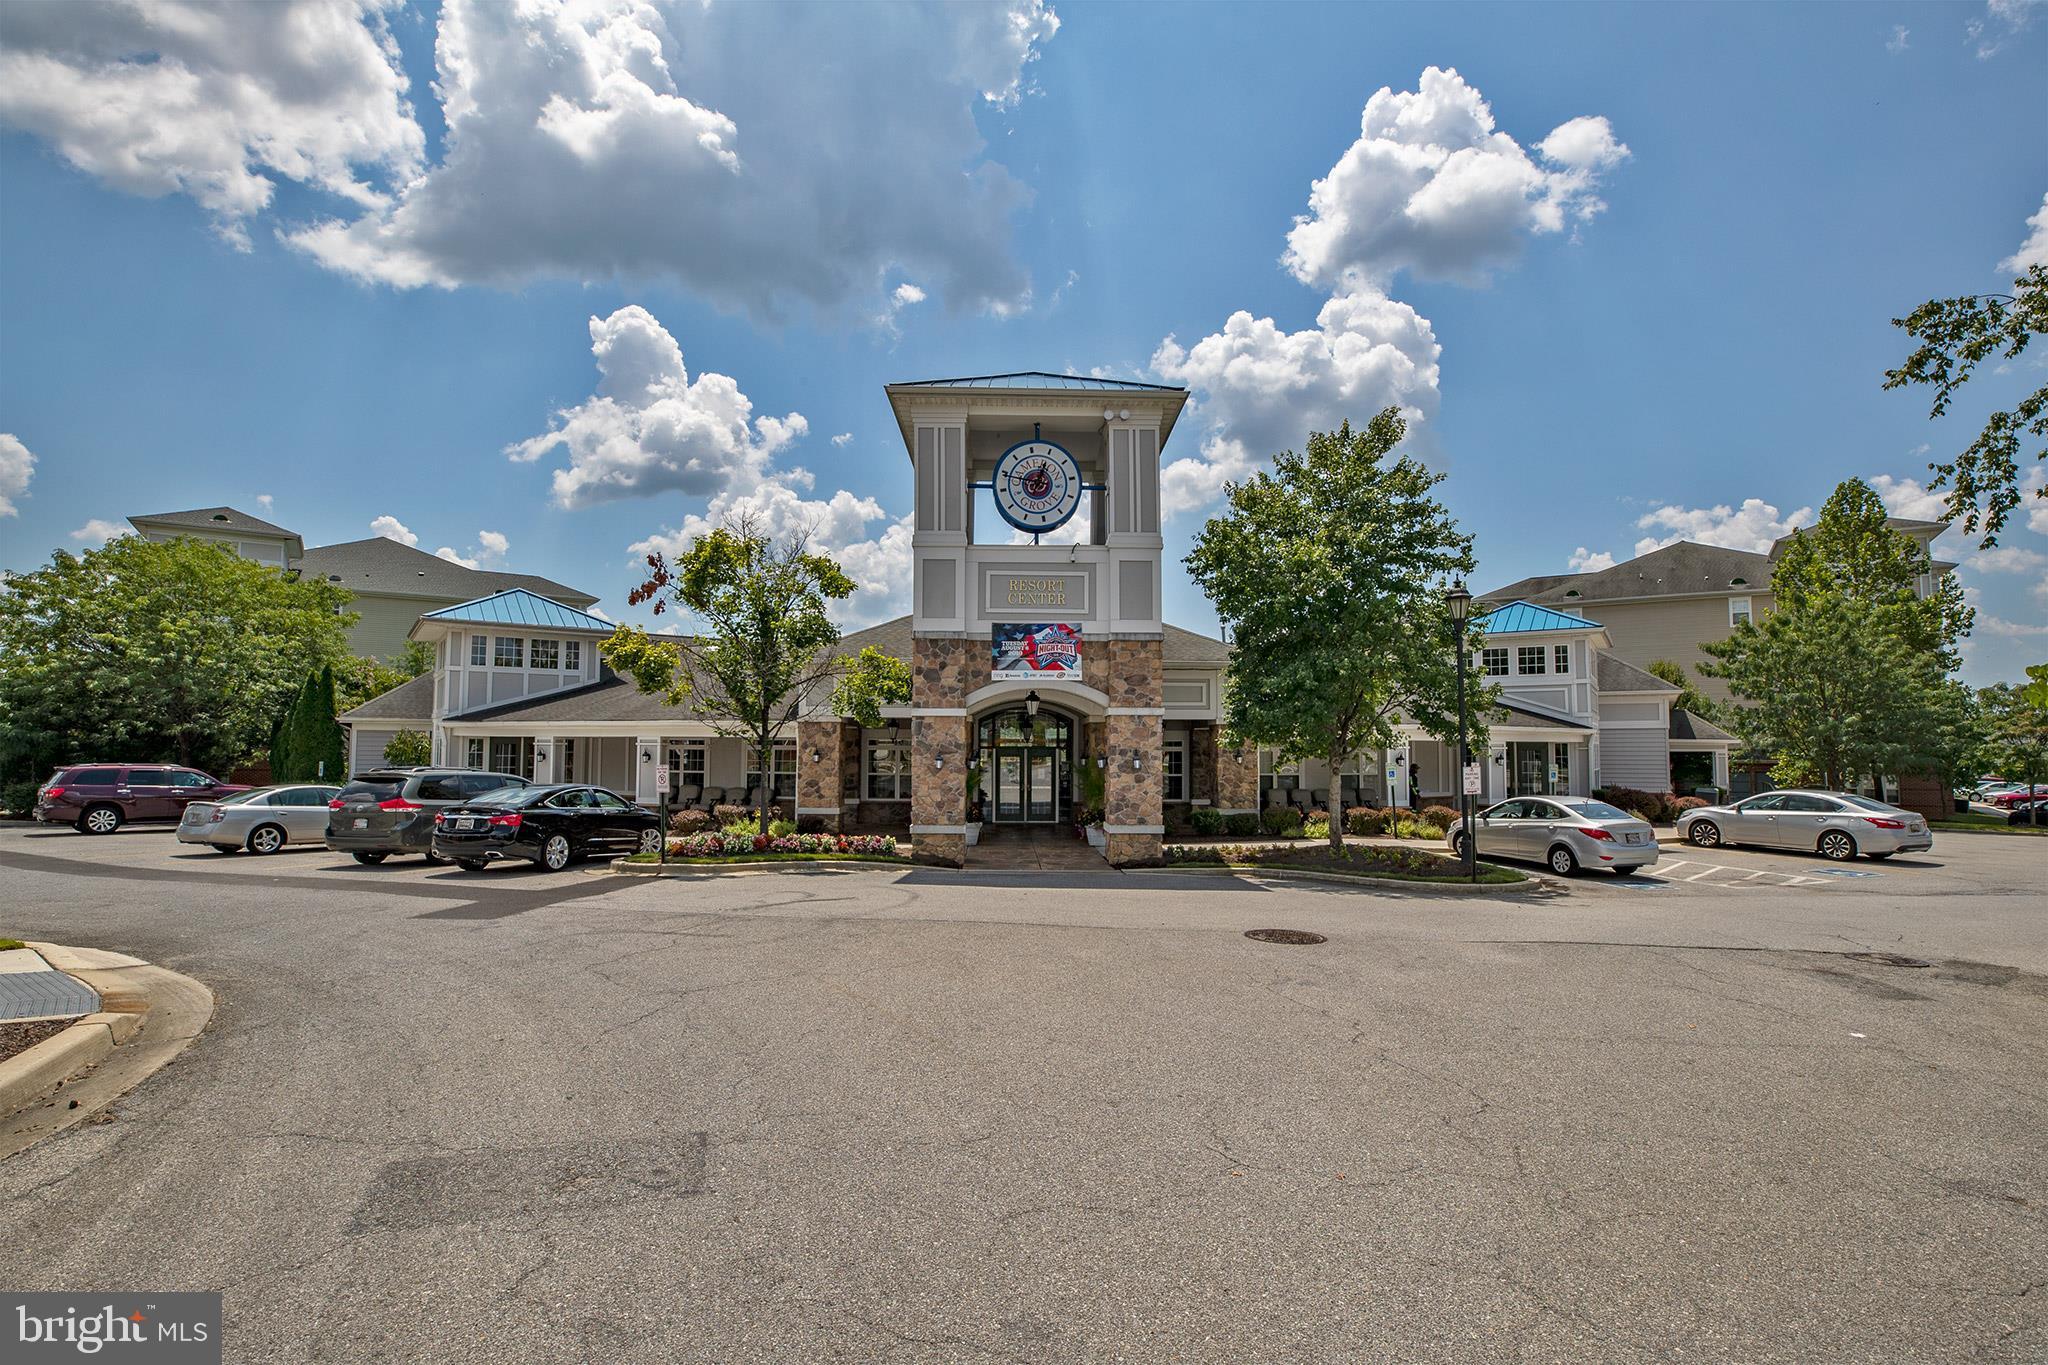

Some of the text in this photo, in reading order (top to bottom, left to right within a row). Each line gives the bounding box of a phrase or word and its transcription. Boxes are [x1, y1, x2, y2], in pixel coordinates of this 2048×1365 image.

[1020, 492, 1061, 511] GROVE
[1009, 579, 1065, 592] RESORT
[1007, 593, 1066, 606] CENTER
